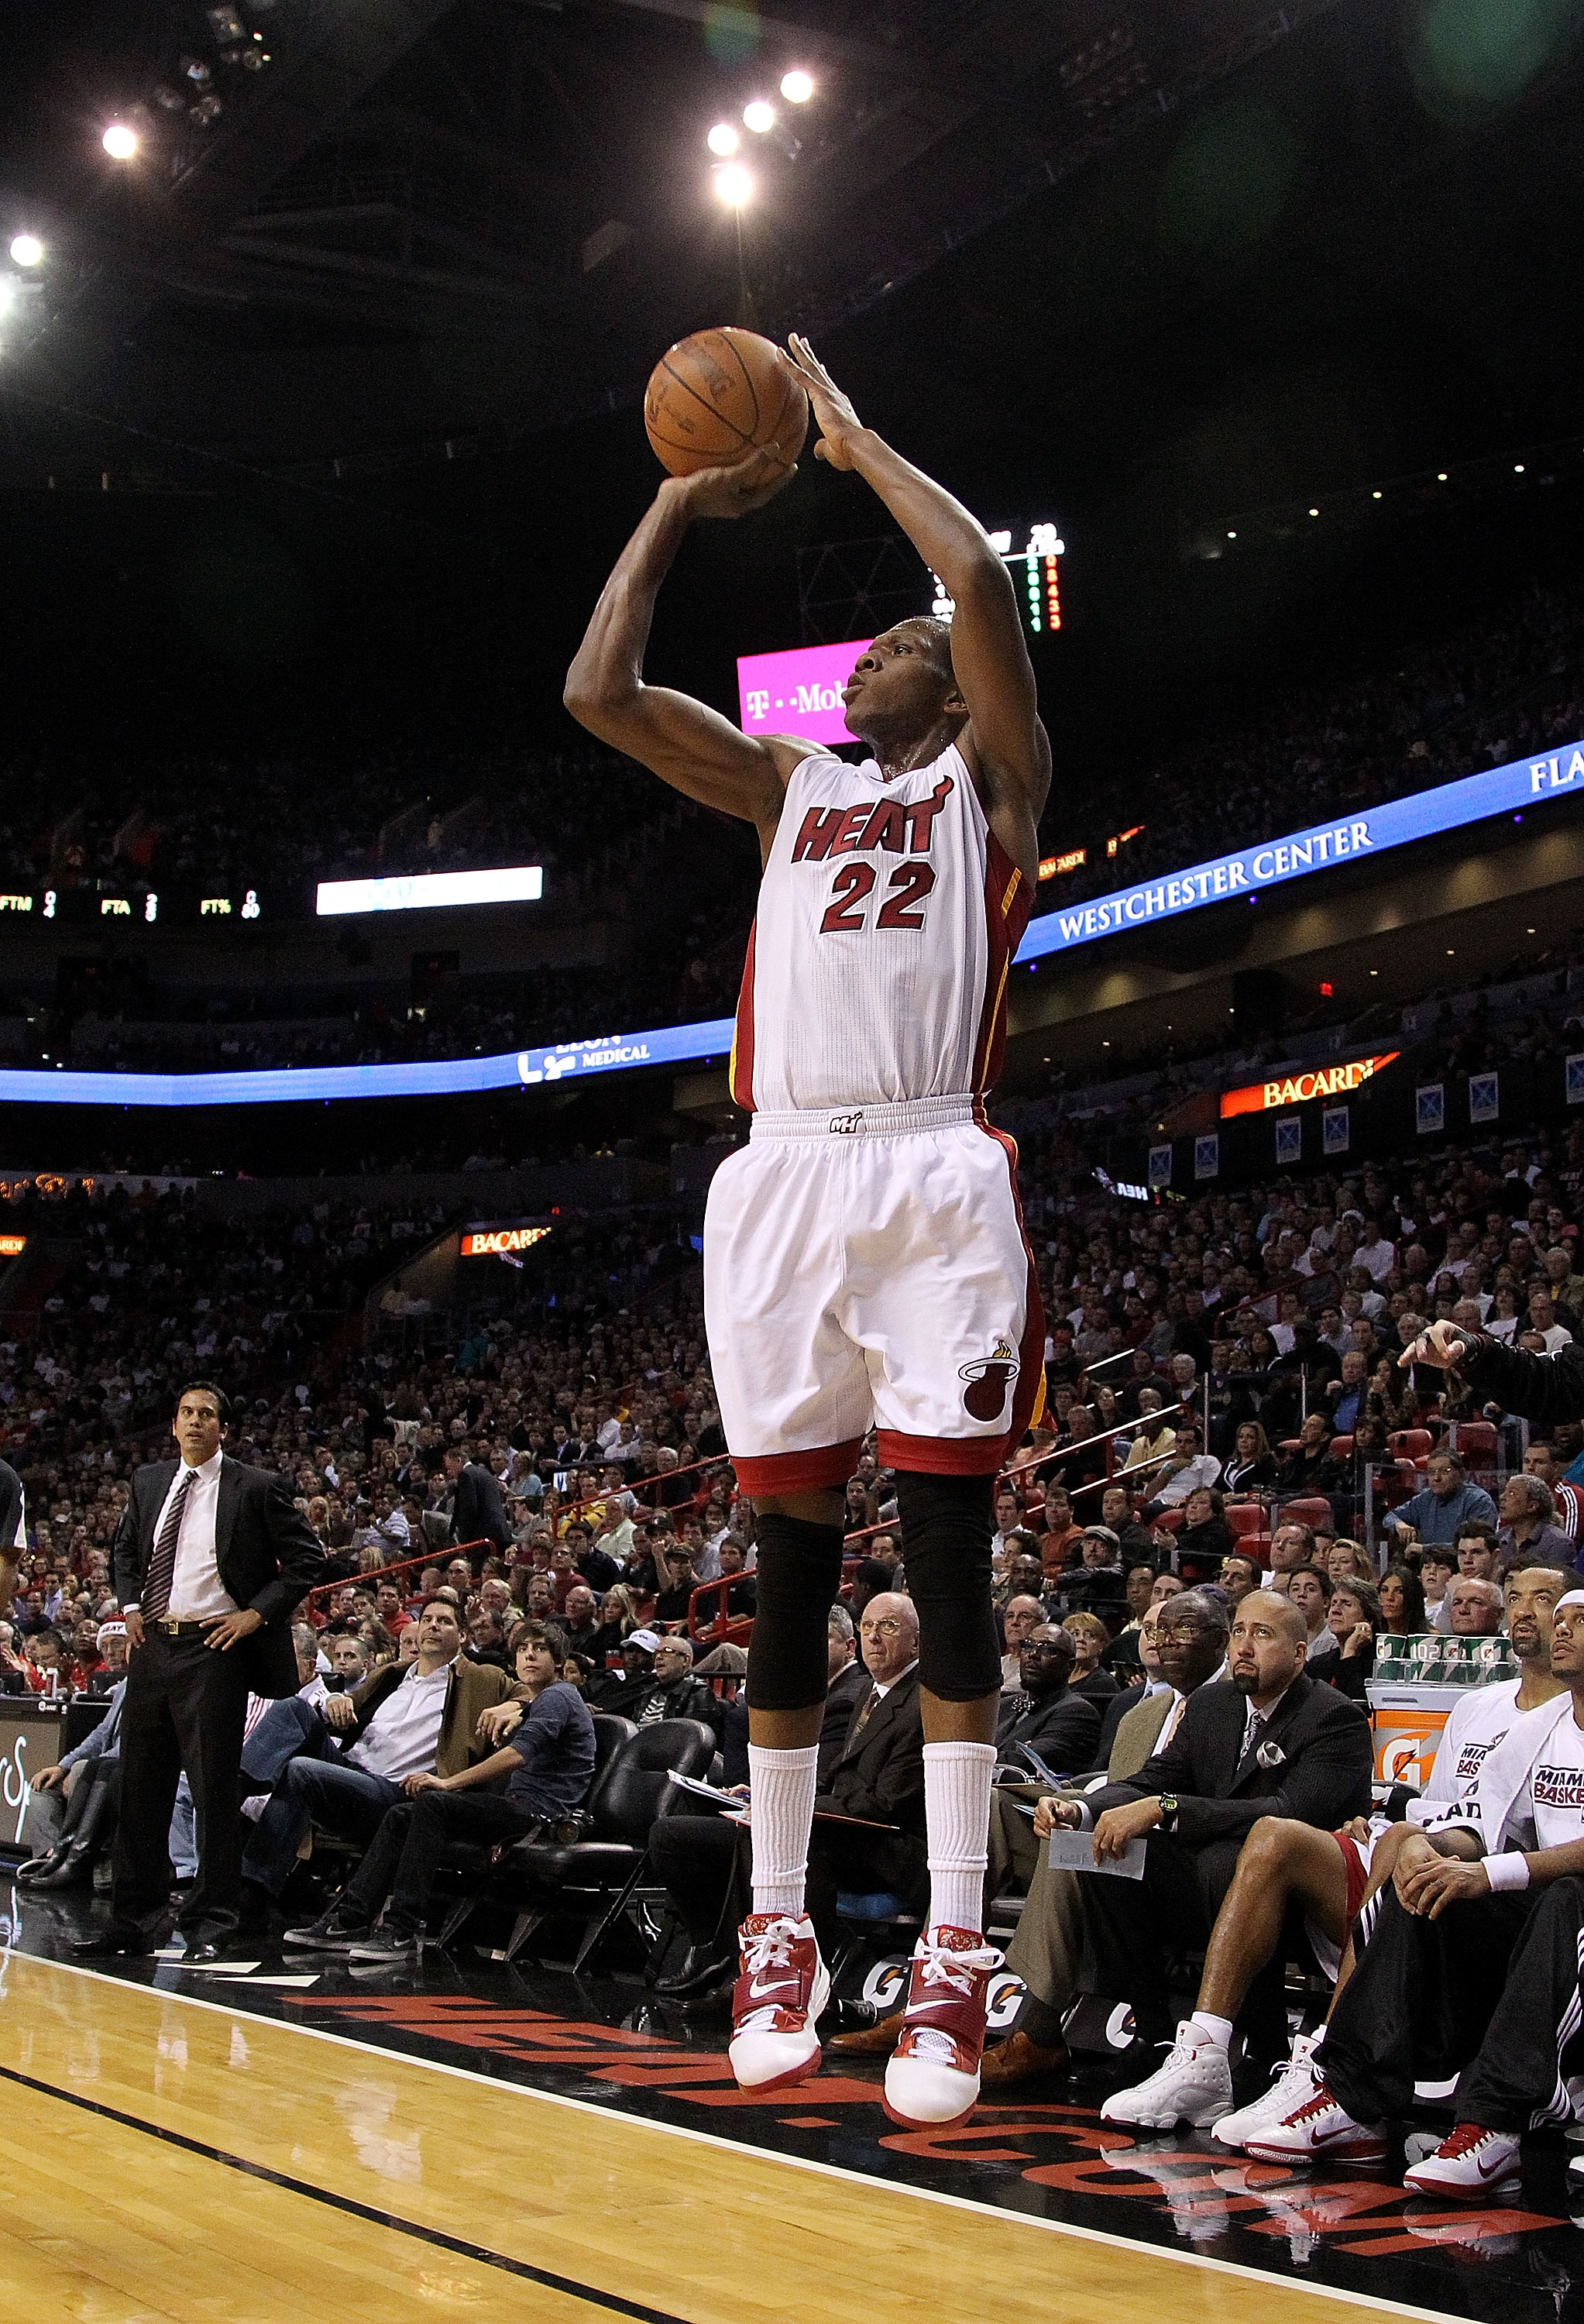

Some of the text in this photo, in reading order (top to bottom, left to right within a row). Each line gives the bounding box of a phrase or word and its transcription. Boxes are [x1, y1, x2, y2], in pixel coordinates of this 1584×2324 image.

[1529, 750, 1584, 793] FLA
[791, 775, 954, 864] HEAT
[819, 861, 936, 934] 22
[1059, 821, 1373, 940] WESTCHESTER CENTER
[0, 895, 33, 911] FTM
[101, 899, 131, 915] FTA
[582, 1044, 651, 1067] MEDICAL
